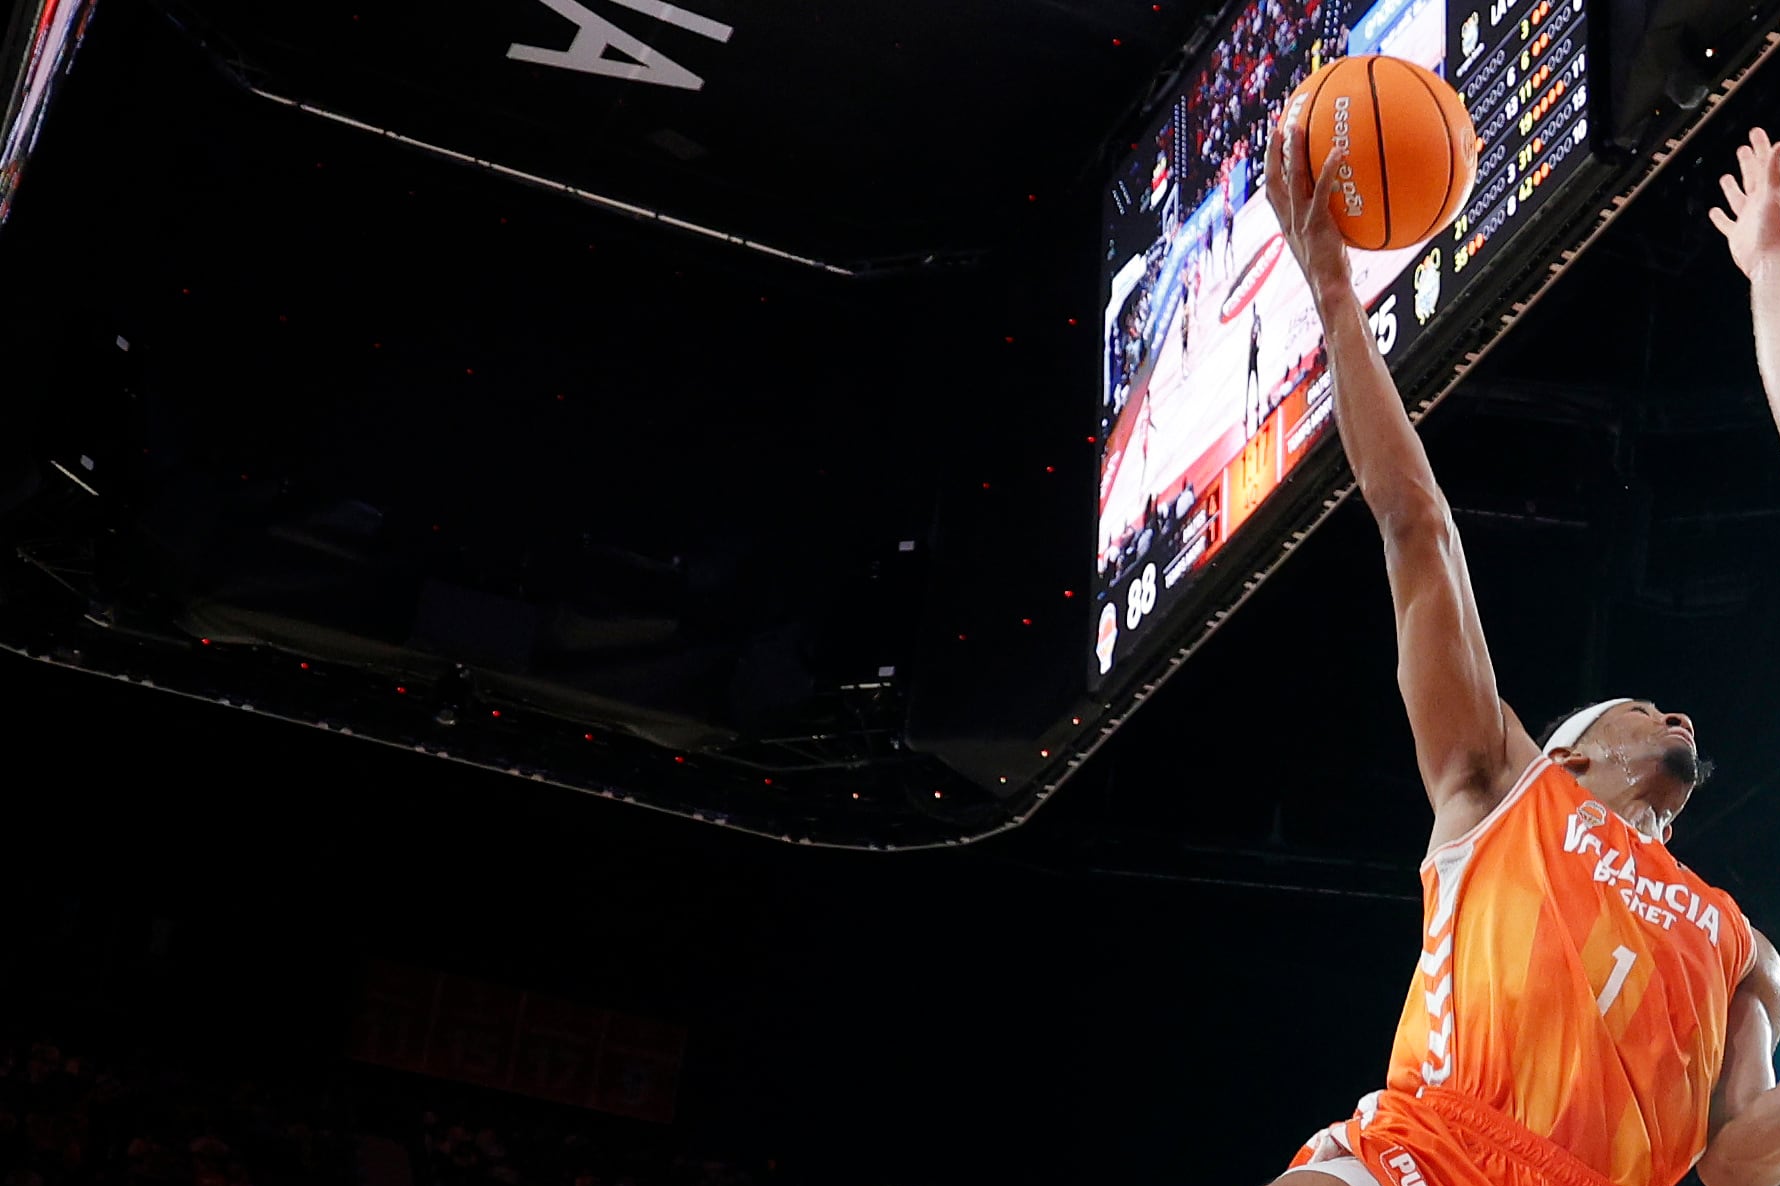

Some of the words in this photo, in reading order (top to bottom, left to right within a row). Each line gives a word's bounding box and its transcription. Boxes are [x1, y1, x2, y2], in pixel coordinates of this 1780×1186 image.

[1572, 53, 1586, 78] 11
[1572, 119, 1588, 144] 10
[1126, 563, 1157, 630] 88
[1595, 944, 1638, 1007] 1
